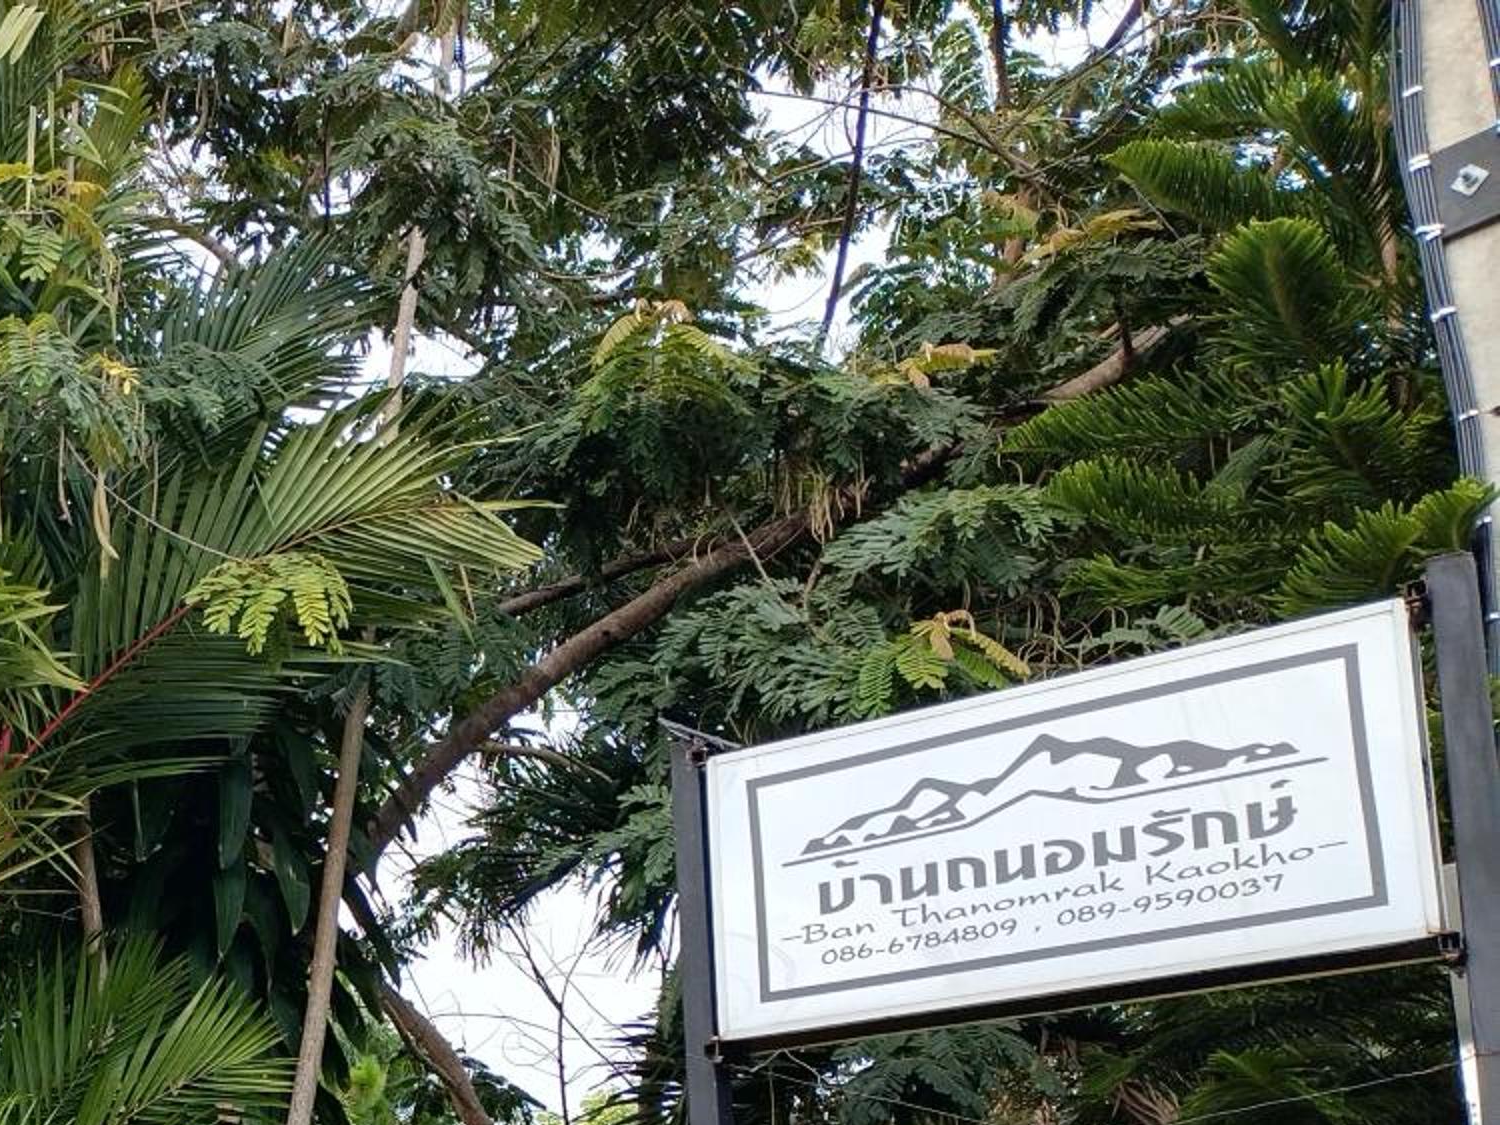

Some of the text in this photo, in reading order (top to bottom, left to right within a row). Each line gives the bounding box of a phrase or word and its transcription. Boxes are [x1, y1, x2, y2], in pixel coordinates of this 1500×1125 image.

[818, 779, 1299, 916] บ้านถนอมรักษ์
[820, 918, 1017, 965] 086-6784809
[1056, 873, 1284, 928] 089-9590037
[891, 871, 1124, 927] Thanomrak
